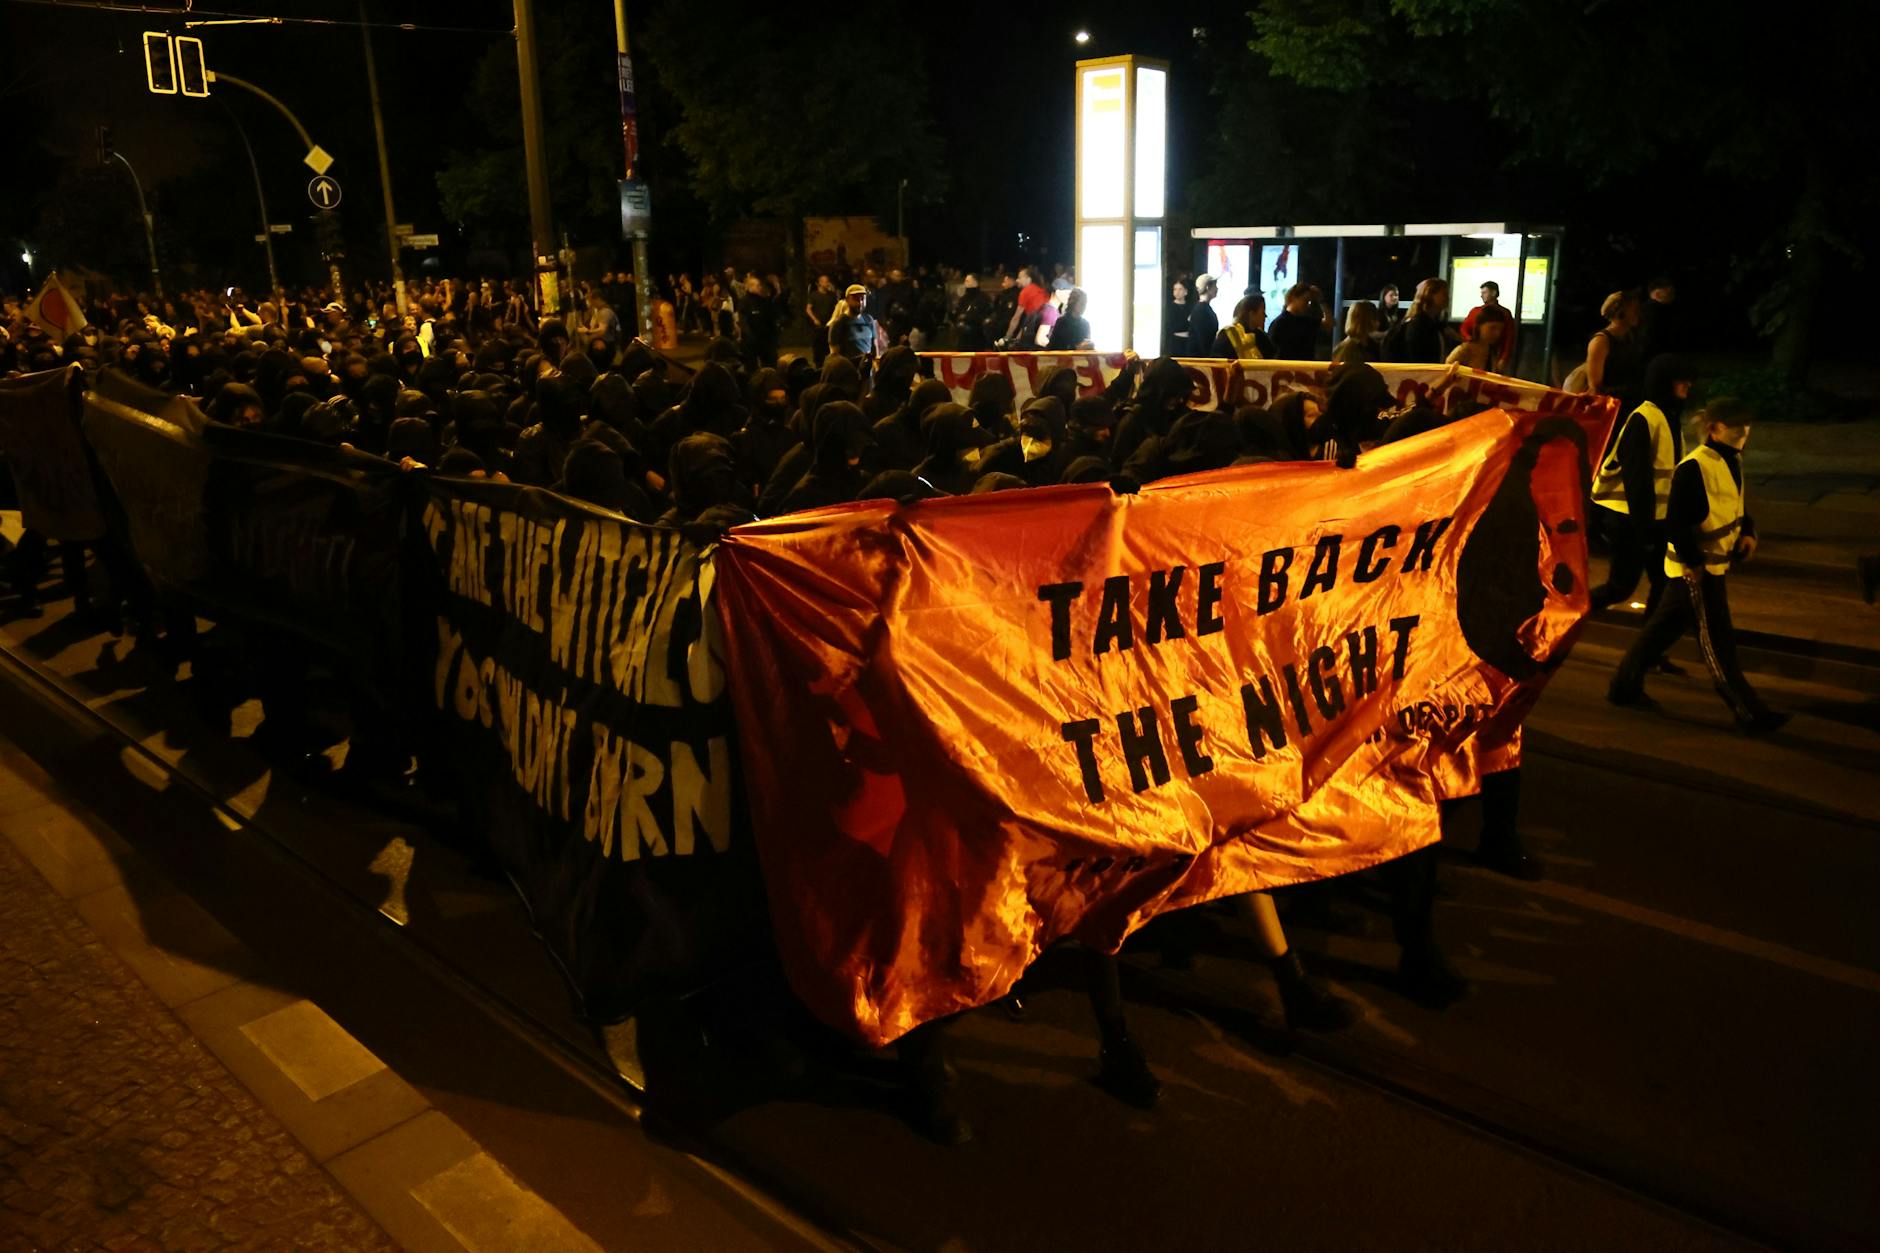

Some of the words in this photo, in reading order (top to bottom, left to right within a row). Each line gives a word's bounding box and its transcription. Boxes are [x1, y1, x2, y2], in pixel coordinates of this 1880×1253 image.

[449, 498, 492, 607] ARE
[499, 510, 551, 635] THE
[1038, 561, 1225, 661] TAKE
[1257, 516, 1454, 617] BACK
[1061, 694, 1214, 804] THE
[1240, 614, 1420, 759] NIGHT
[584, 720, 733, 863] BURN
